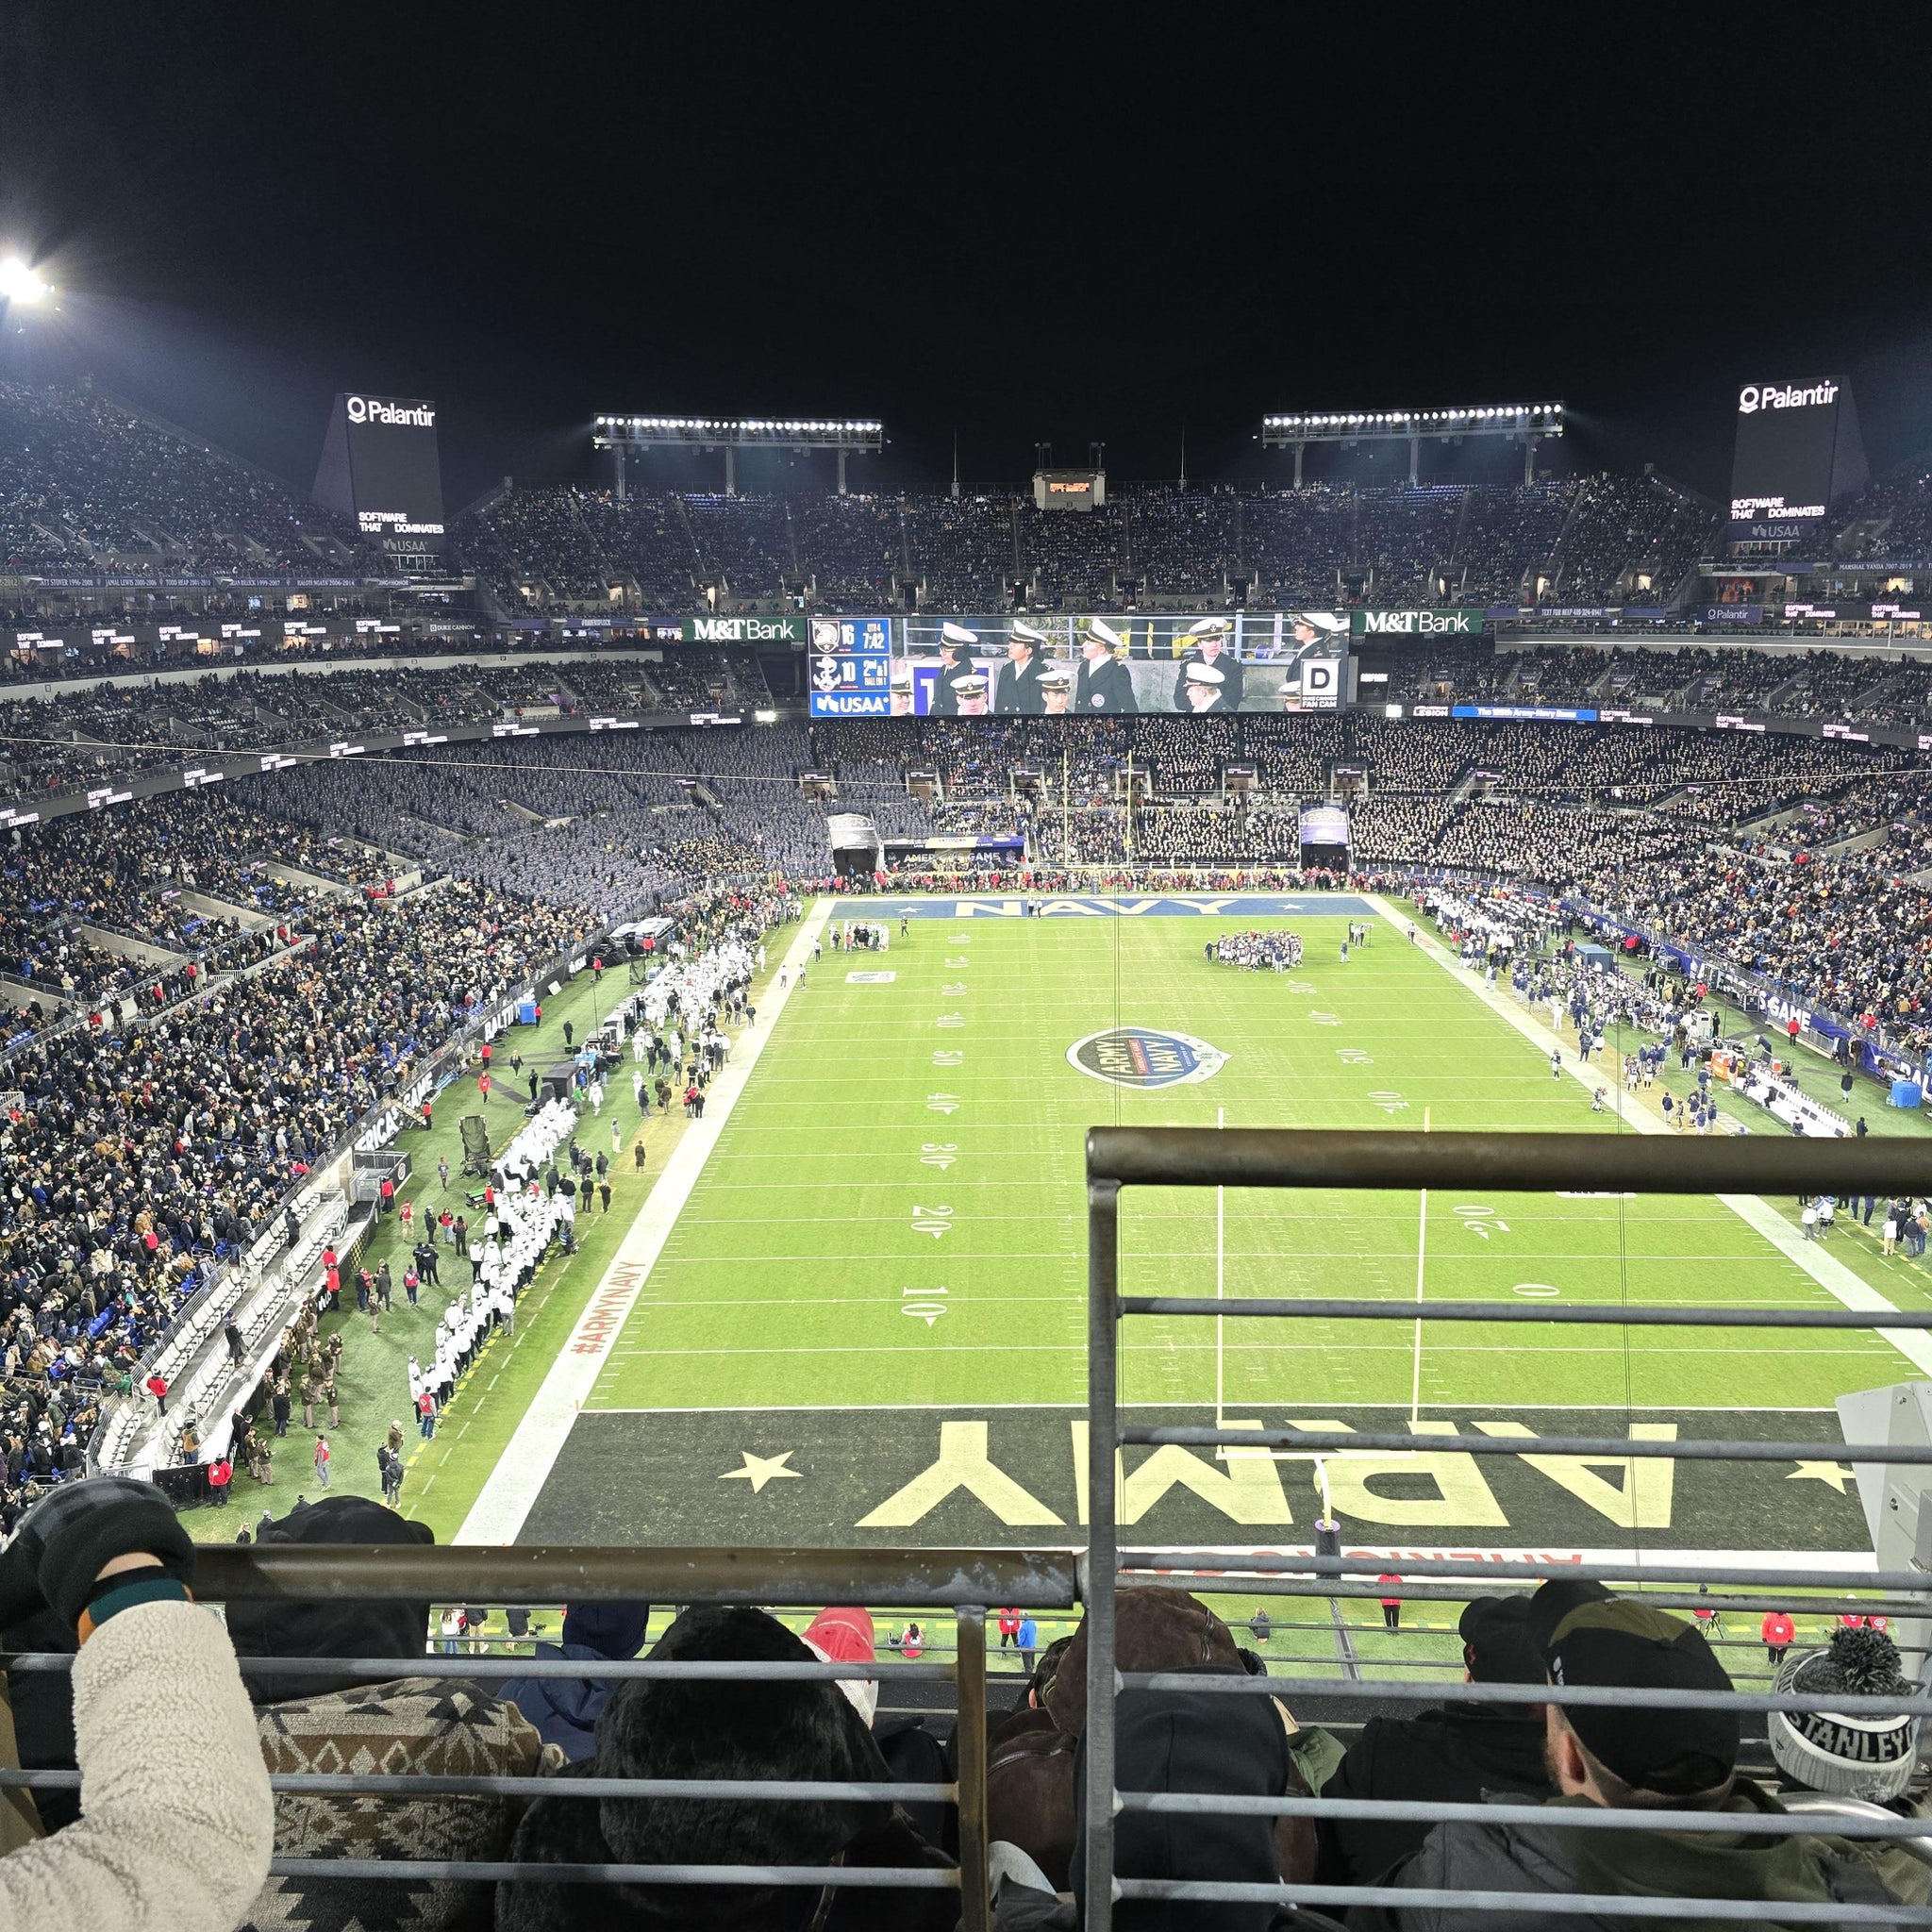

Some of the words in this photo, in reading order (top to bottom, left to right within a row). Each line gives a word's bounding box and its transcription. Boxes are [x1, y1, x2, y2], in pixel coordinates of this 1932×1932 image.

[1761, 380, 1839, 409] Palantir
[368, 400, 436, 426] Palantir
[1731, 509, 1755, 519] THAT
[1768, 506, 1824, 519] DOMINATES
[1732, 497, 1785, 509] SOFTWARE
[358, 511, 408, 523] SOFTWARE
[359, 523, 383, 532] THAT
[394, 525, 444, 534] DOMINATES
[1768, 525, 1800, 538] USAA
[398, 541, 425, 552] USAA
[1364, 612, 1417, 634] M&T
[1419, 611, 1470, 633] Bank
[1717, 609, 1749, 619] Palantir
[694, 619, 745, 641] M&T
[747, 620, 795, 640] Bank
[841, 625, 856, 646] 16
[863, 633, 885, 650] 7:42
[841, 662, 856, 682] 10
[863, 660, 877, 677] 2nd
[1311, 668, 1330, 690] D
[840, 696, 885, 713] USAA
[1477, 708, 1491, 717] The
[1513, 708, 1556, 718] Army-Navy
[969, 853, 1000, 862] GAME
[955, 900, 1240, 917] NAVY
[1768, 996, 1812, 1034] GAME
[932, 1050, 964, 1066] 50
[1095, 1038, 1134, 1074] ARMY
[1143, 1040, 1185, 1073] NAVY
[1336, 1049, 1374, 1064] 50
[404, 1072, 434, 1110] GAME
[1368, 1091, 1411, 1109] 40
[926, 1092, 961, 1111] 40
[920, 1143, 958, 1164] 30
[911, 1205, 955, 1232] 20
[1453, 1206, 1511, 1232] 20
[571, 1261, 646, 1355] #ARMYNAVY
[901, 1286, 949, 1317] 10
[853, 1419, 1679, 1528] ARMY
[1787, 1712, 1905, 1762] STANLEY
